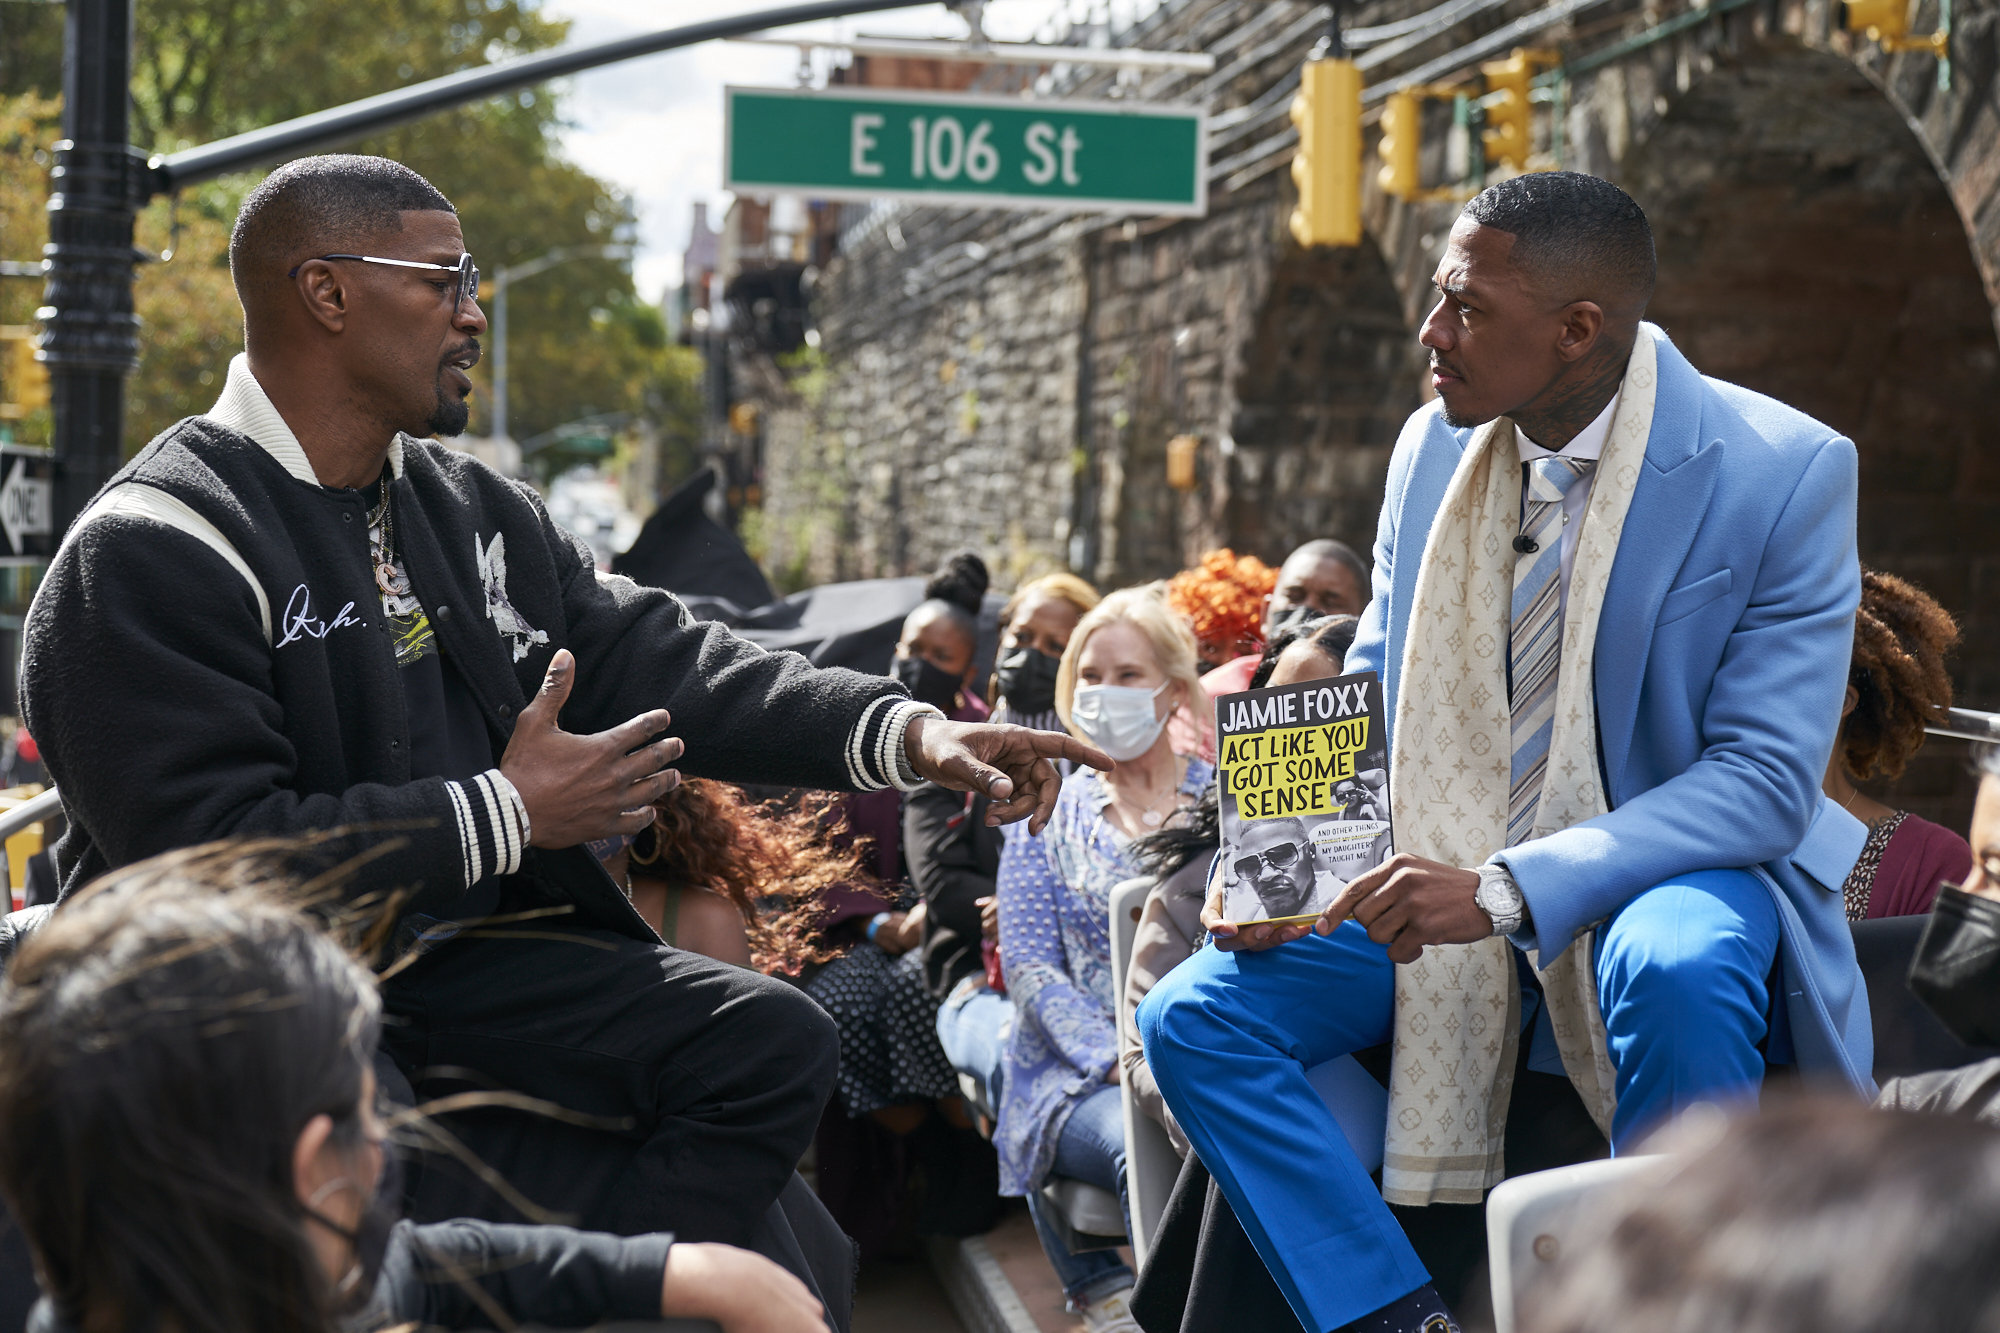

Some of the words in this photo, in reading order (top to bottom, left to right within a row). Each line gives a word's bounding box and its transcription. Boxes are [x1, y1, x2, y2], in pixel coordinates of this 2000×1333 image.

[850, 113, 885, 176] E
[910, 115, 1000, 182] 106
[1022, 121, 1083, 186] St
[6, 486, 36, 525] ONE
[1222, 692, 1297, 732] JAMIE
[1303, 681, 1369, 721] FOXX
[1225, 736, 1264, 765] ACT
[1322, 721, 1364, 751] YOU
[1232, 761, 1280, 790] GOT
[1285, 751, 1351, 783] SOME
[1244, 781, 1326, 818] SENSE
[1317, 829, 1331, 837] AND
[1332, 826, 1353, 835] OTHER
[1333, 841, 1374, 853] DAUGHTERS
[1328, 854, 1354, 863] TAUGHT
